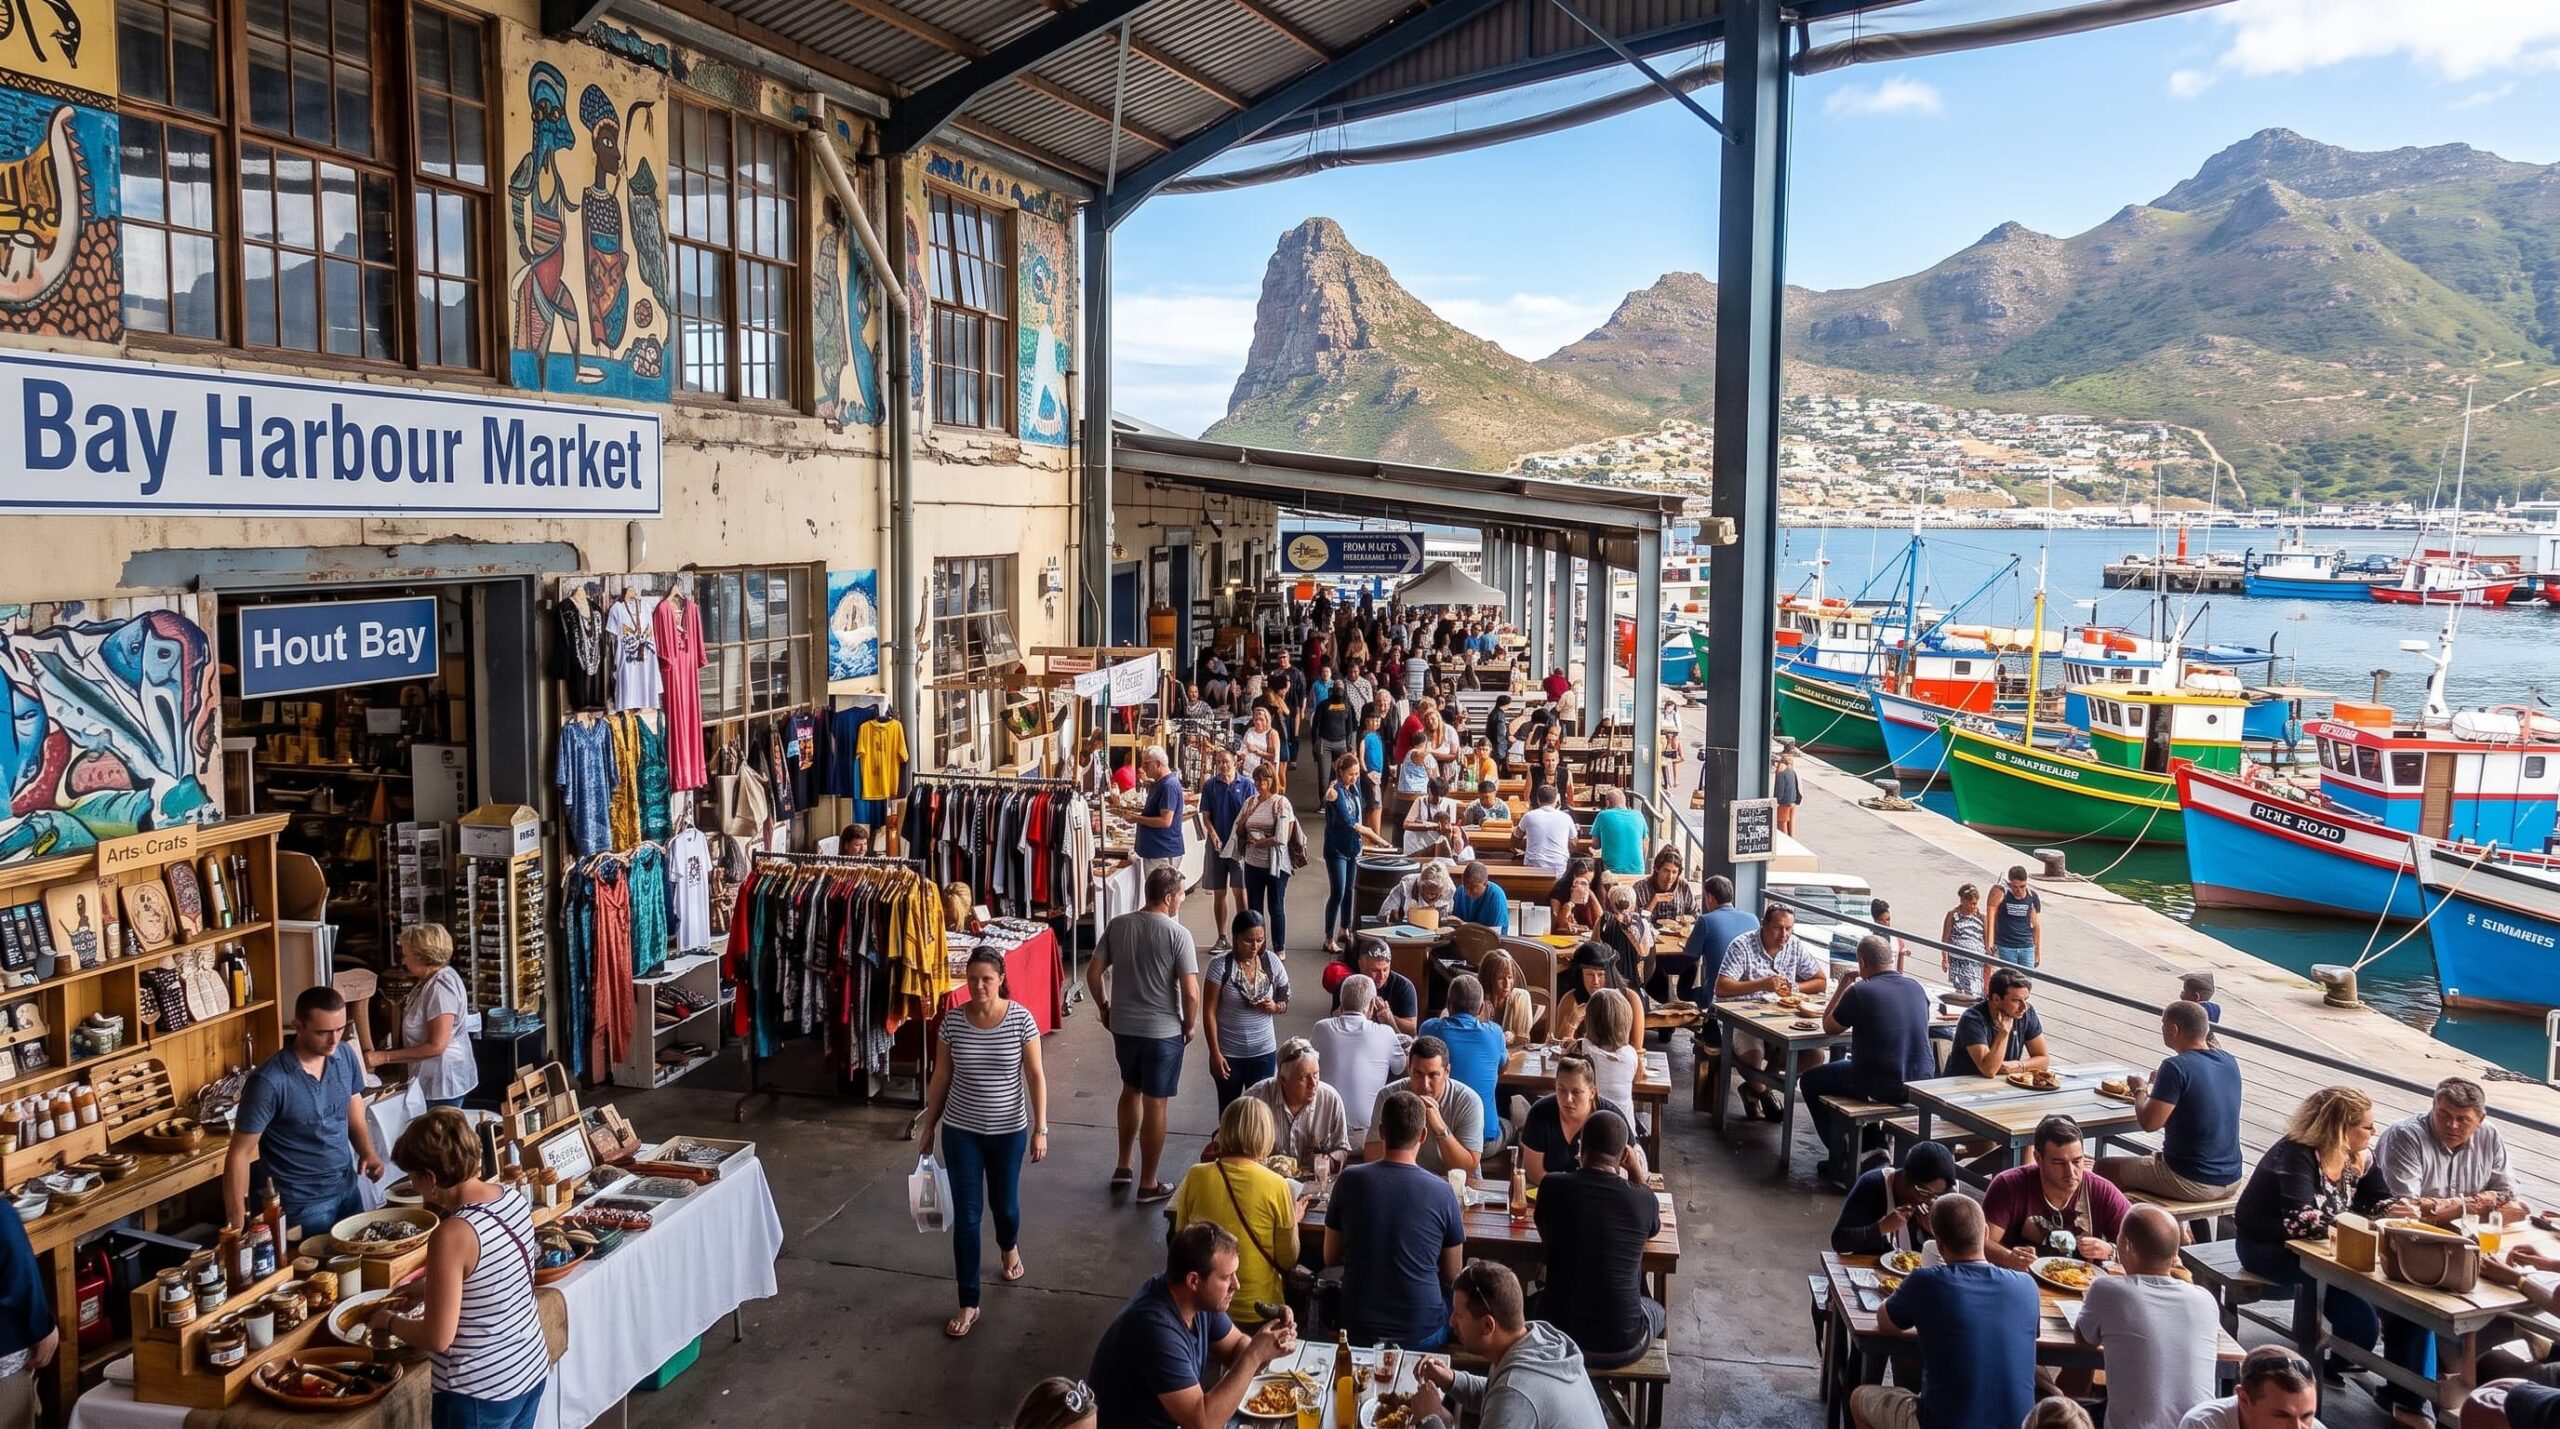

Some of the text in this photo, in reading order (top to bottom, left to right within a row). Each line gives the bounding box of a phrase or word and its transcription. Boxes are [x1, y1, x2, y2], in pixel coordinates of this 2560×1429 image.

[23, 378, 642, 496] Bay Harbour Market
[254, 620, 427, 669] Hout Bay
[2296, 818, 2340, 840] ROAD
[106, 846, 140, 864] Arts
